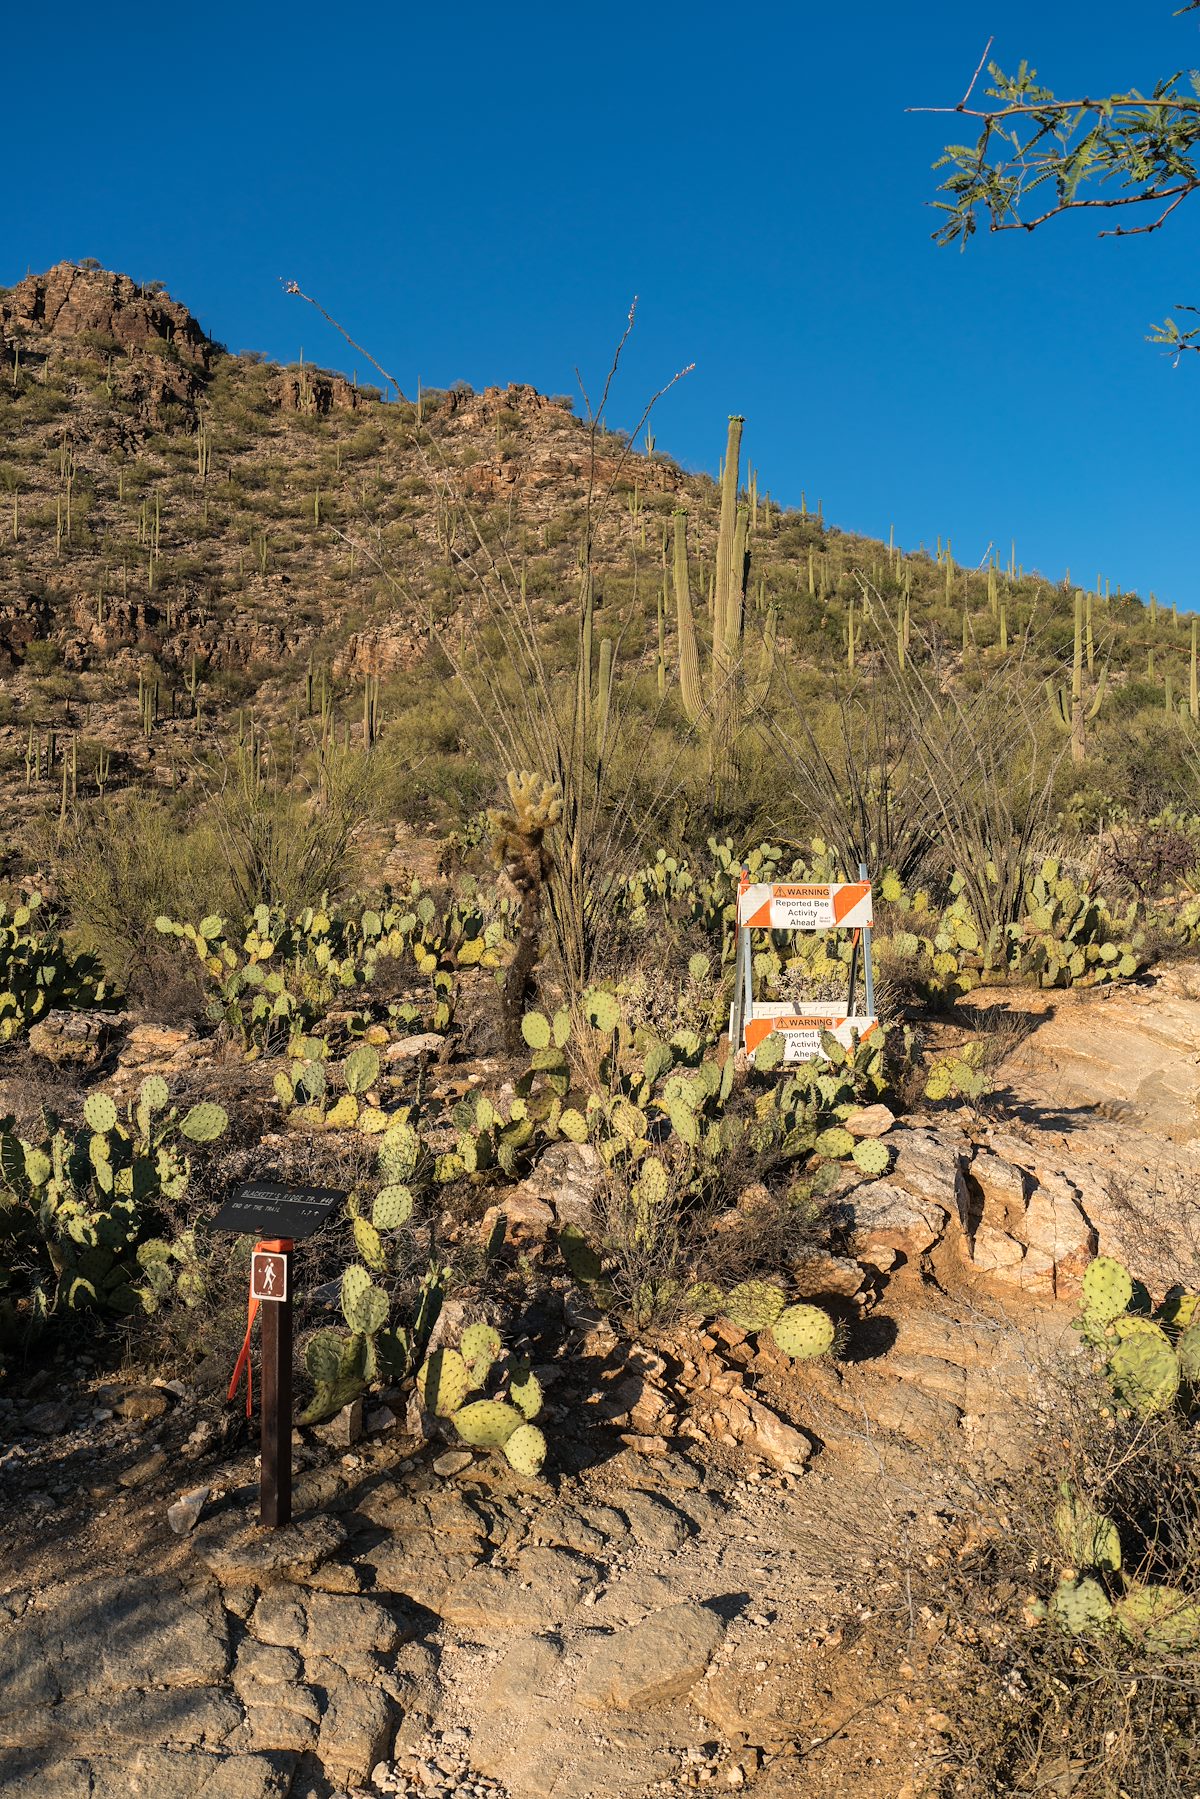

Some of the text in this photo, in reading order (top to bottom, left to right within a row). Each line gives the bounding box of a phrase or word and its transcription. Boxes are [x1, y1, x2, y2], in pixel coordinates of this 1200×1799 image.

[787, 888, 830, 896] WARNING
[788, 909, 818, 918] Activity
[789, 1018, 833, 1026] WARNING
[242, 1190, 281, 1199] BLACKETT'S
[283, 1194, 304, 1202] RIDGE
